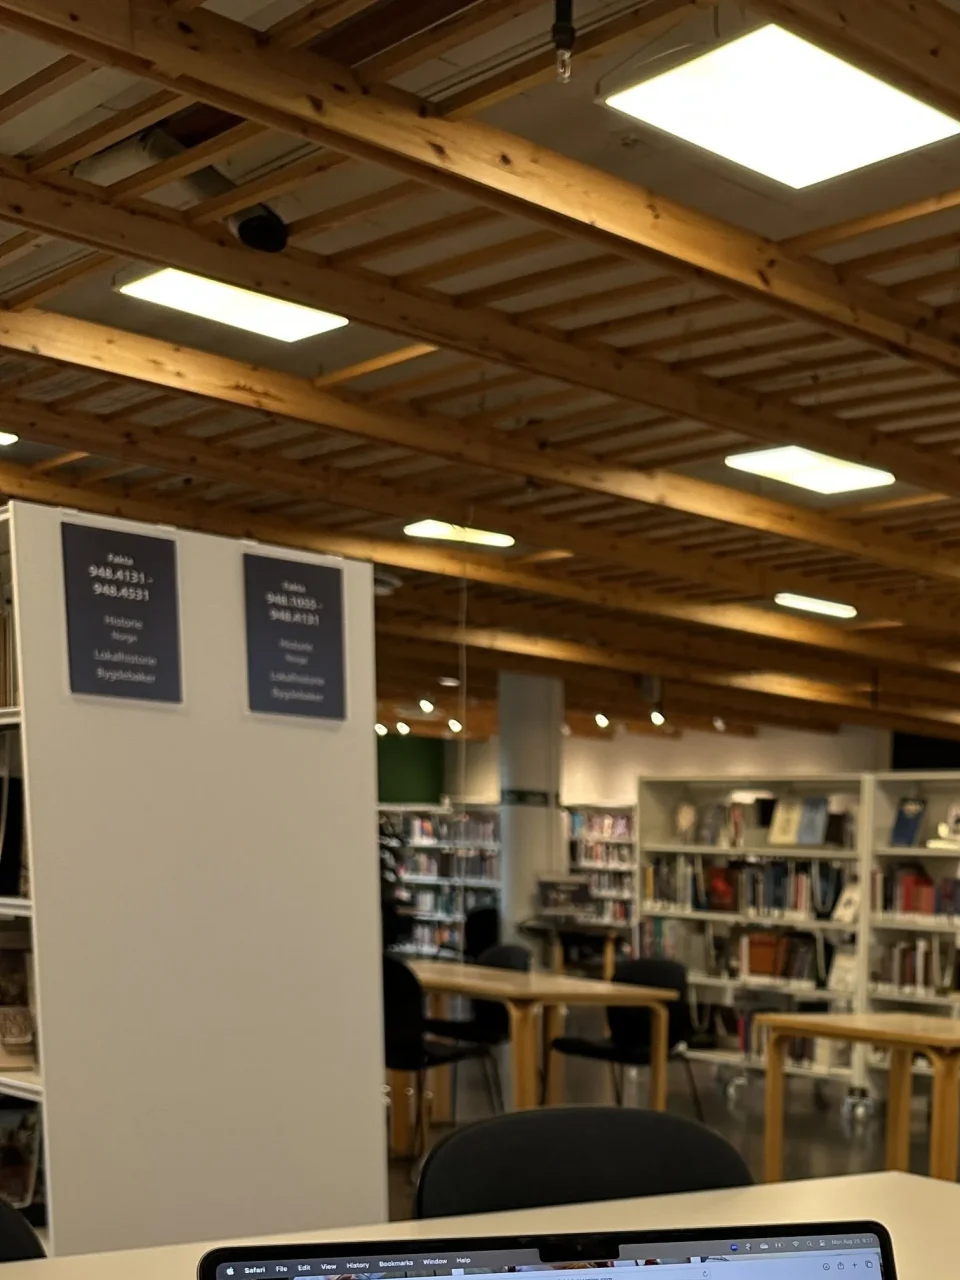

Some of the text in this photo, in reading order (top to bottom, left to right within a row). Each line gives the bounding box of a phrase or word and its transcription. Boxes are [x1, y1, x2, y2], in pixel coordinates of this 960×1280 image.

[244, 1256, 471, 1274] Safari File Edit View History Bookmarks Window Help
